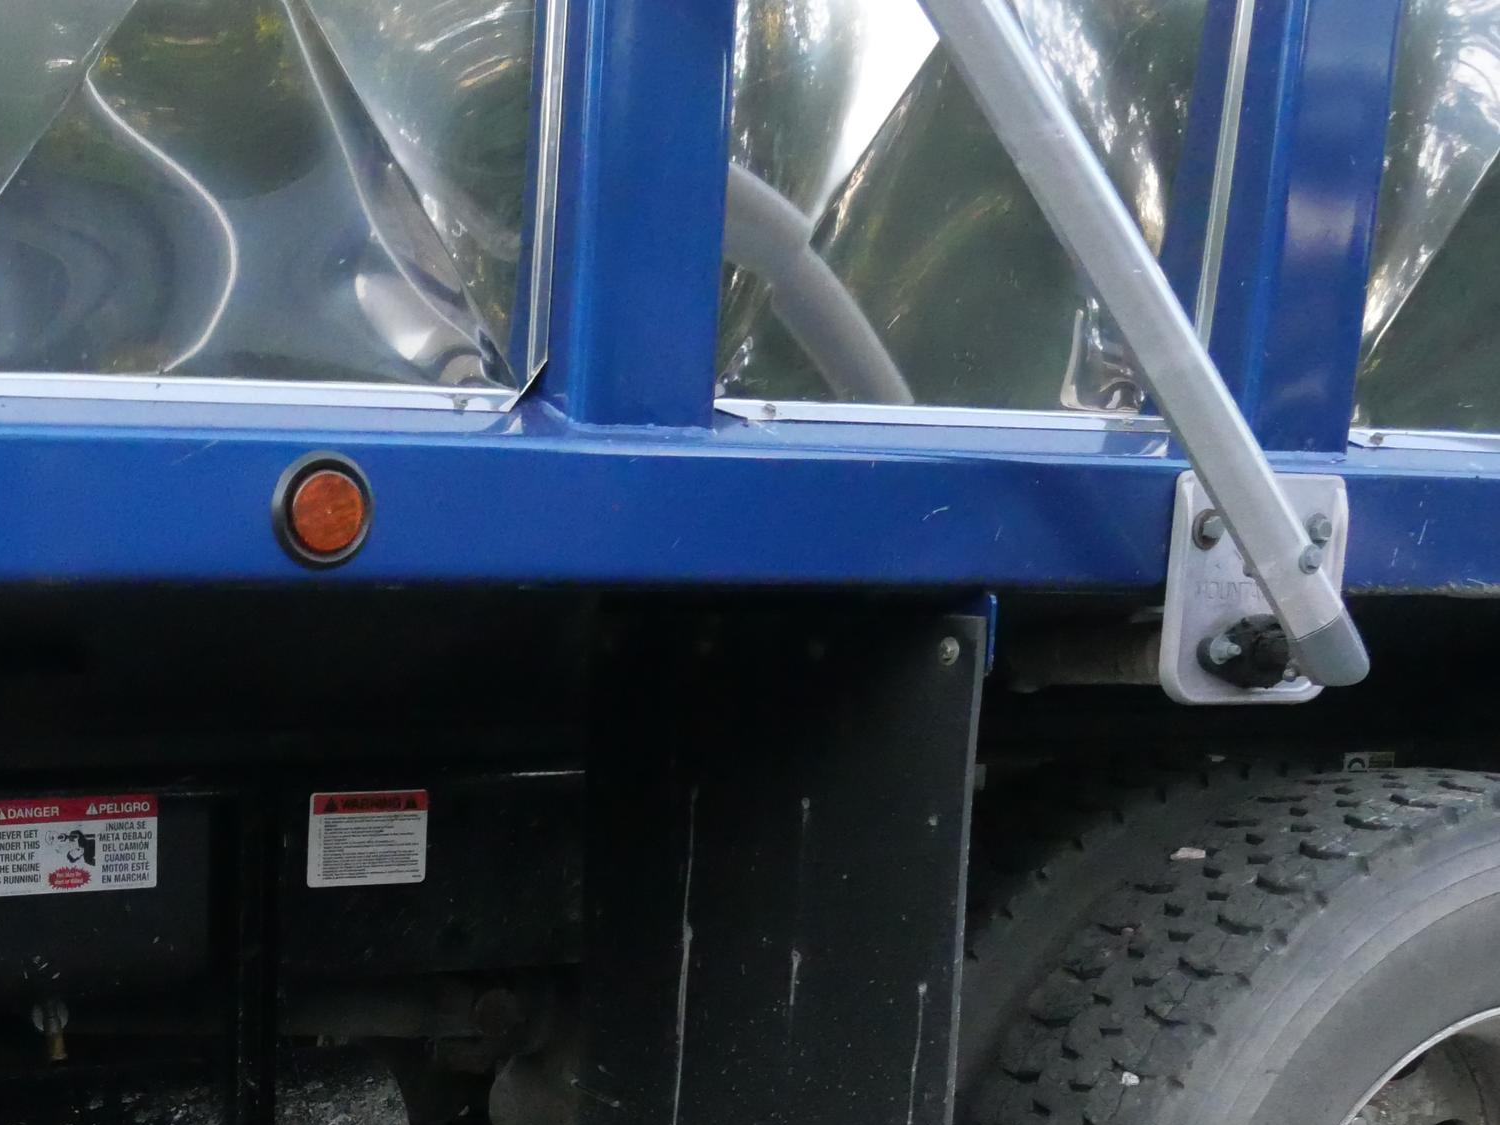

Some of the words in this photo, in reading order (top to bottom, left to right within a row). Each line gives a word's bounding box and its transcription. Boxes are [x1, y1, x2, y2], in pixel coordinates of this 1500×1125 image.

[7, 806, 60, 819] DANGER
[99, 801, 150, 814] PELIGRO
[137, 821, 147, 830] SE
[23, 829, 38, 839] GET
[100, 832, 121, 843] META
[122, 831, 153, 841] DEBAJO
[23, 840, 41, 850] THIS
[102, 843, 117, 852] DEL
[119, 840, 150, 851] CAMIÓN
[0, 852, 26, 863] TRUCK
[28, 851, 35, 861] IF
[104, 853, 136, 863] CUANDO
[138, 852, 147, 861] EL
[12, 862, 40, 873] ENGINE
[102, 863, 129, 873] MOTOR
[131, 861, 150, 871] ESTÉ
[3, 874, 42, 885] RUNNING!
[102, 874, 112, 884] EN
[114, 872, 150, 883] MARCHA!
